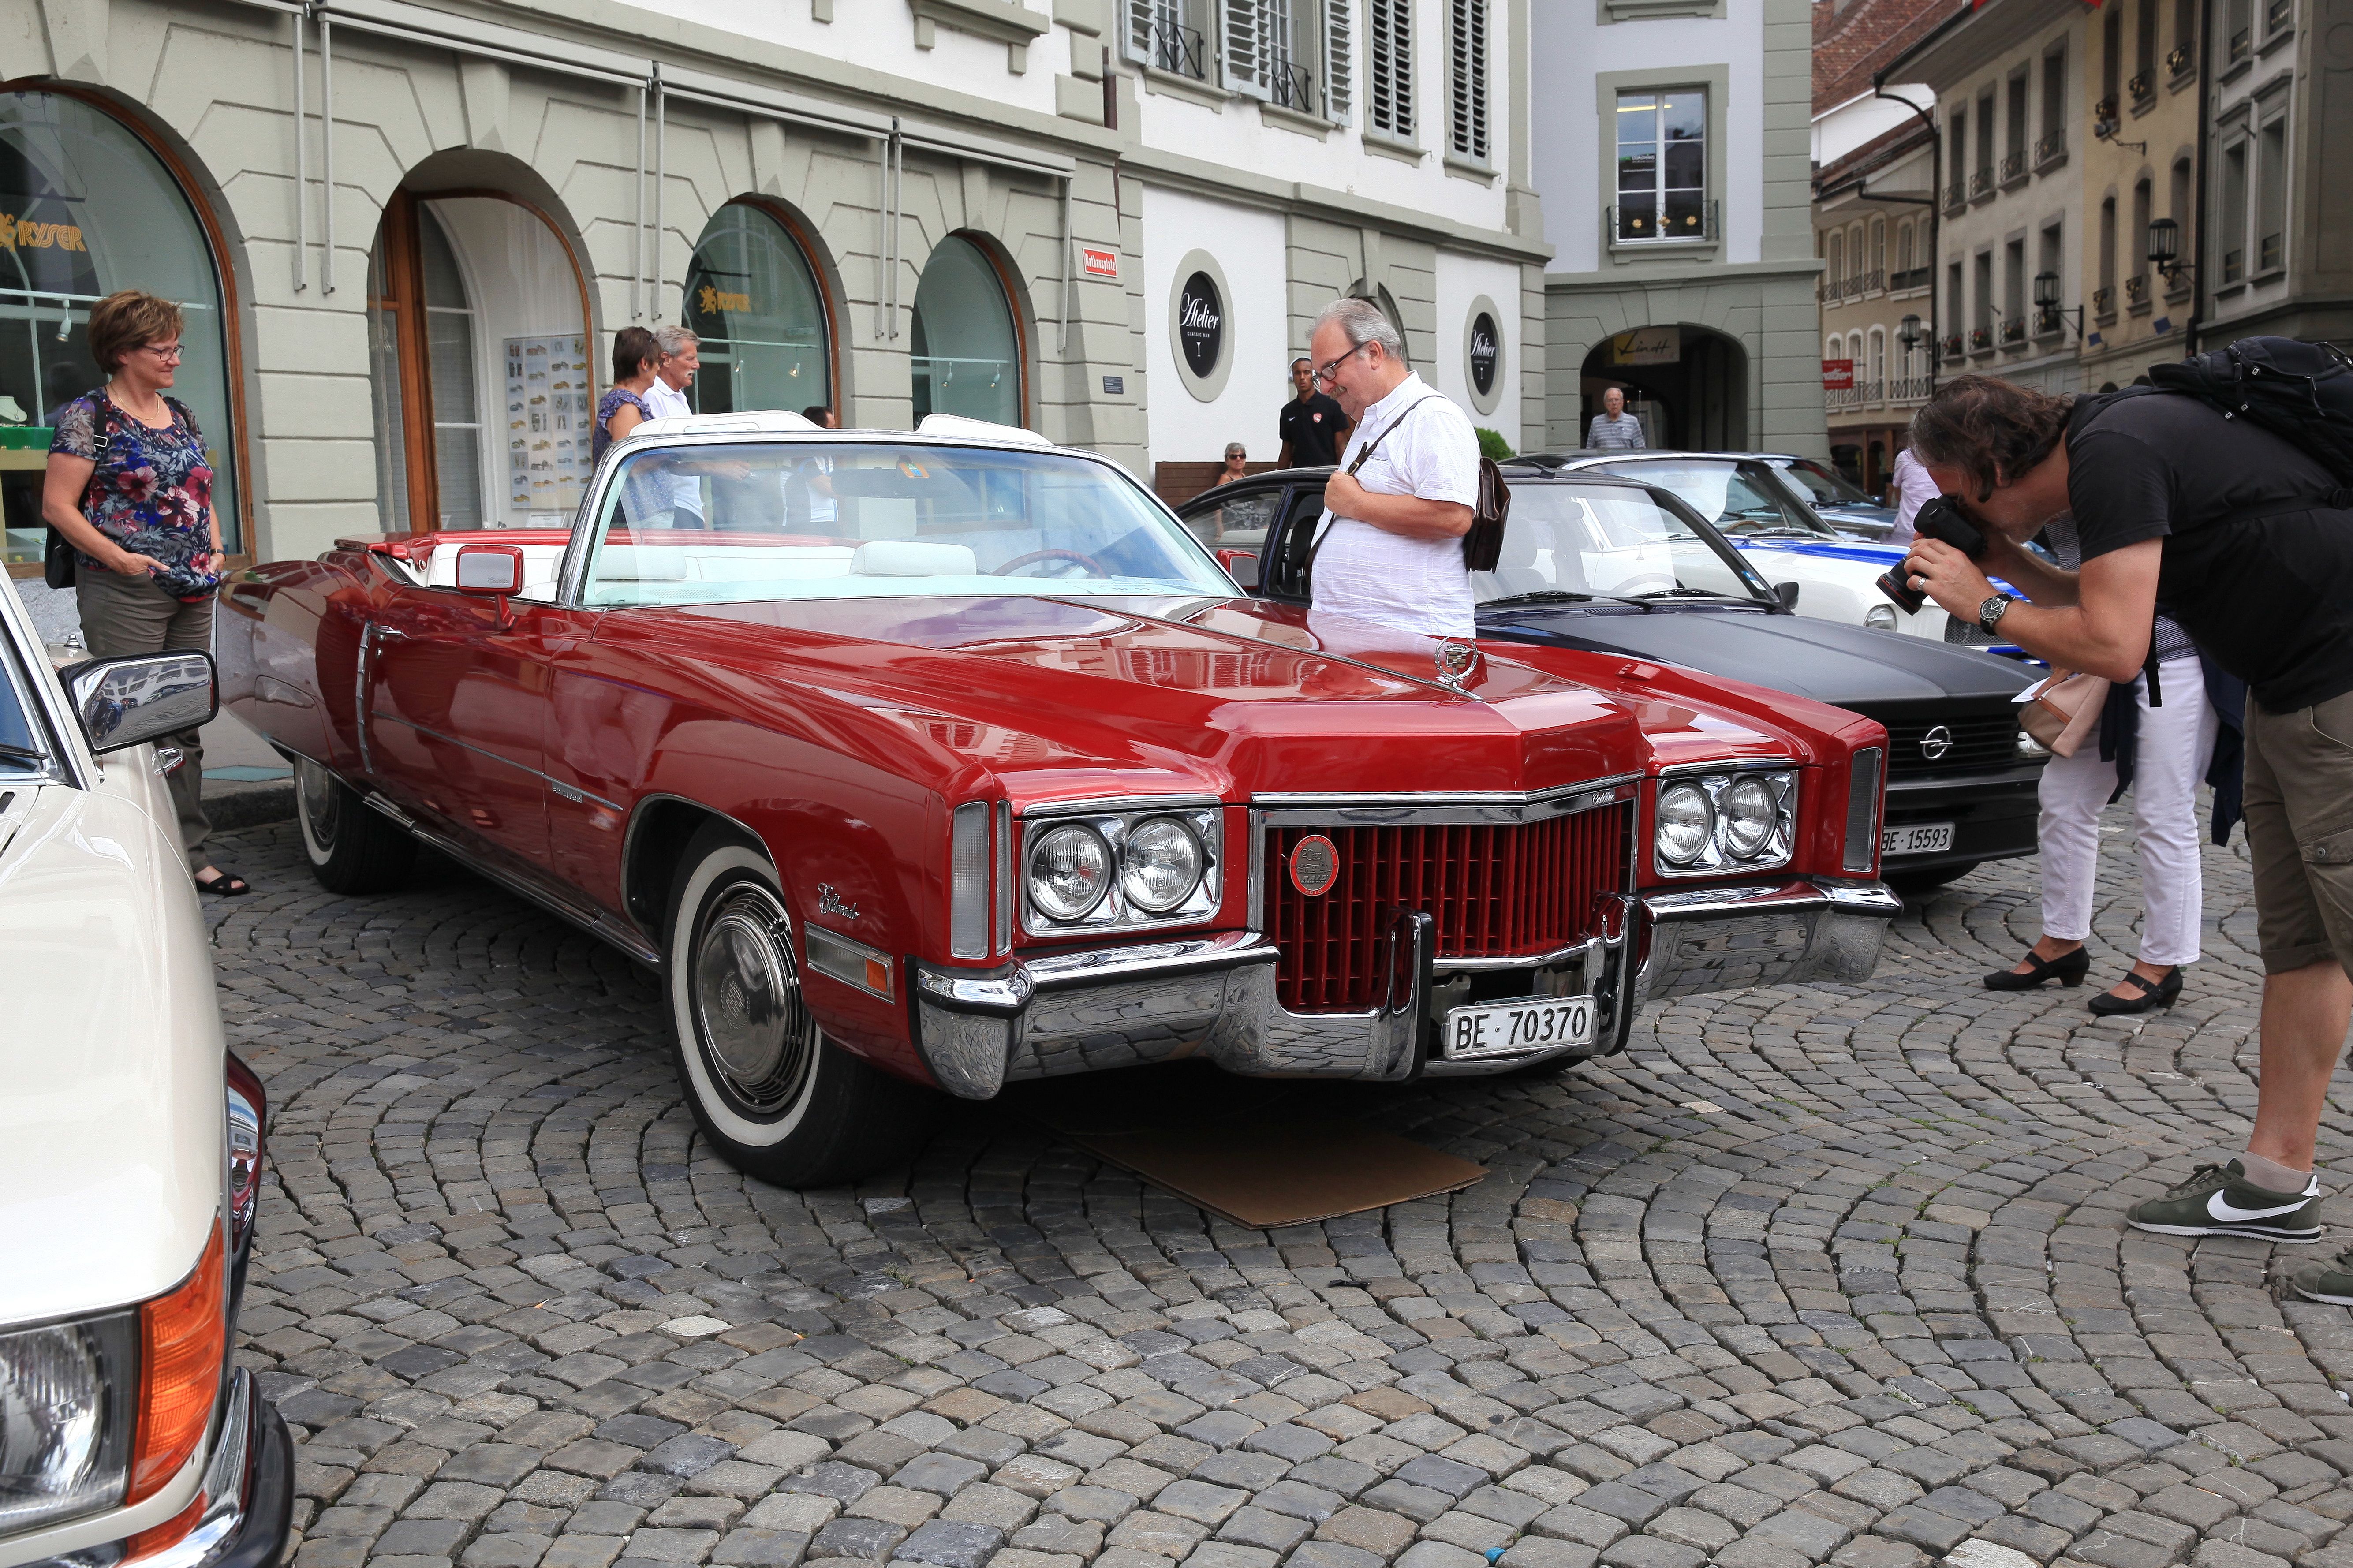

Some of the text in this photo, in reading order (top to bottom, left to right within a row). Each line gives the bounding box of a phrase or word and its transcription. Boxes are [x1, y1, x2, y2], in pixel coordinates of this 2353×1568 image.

[18, 220, 86, 252] RYSER
[1085, 253, 1116, 272] Rathausplatz
[1180, 292, 1219, 329] Atelier
[1471, 329, 1496, 357] Atelier
[1617, 329, 1671, 356] Lindt
[1299, 838, 1311, 849] RAID
[1907, 828, 1949, 850] 15593
[1456, 1005, 1587, 1050] BE 70370
